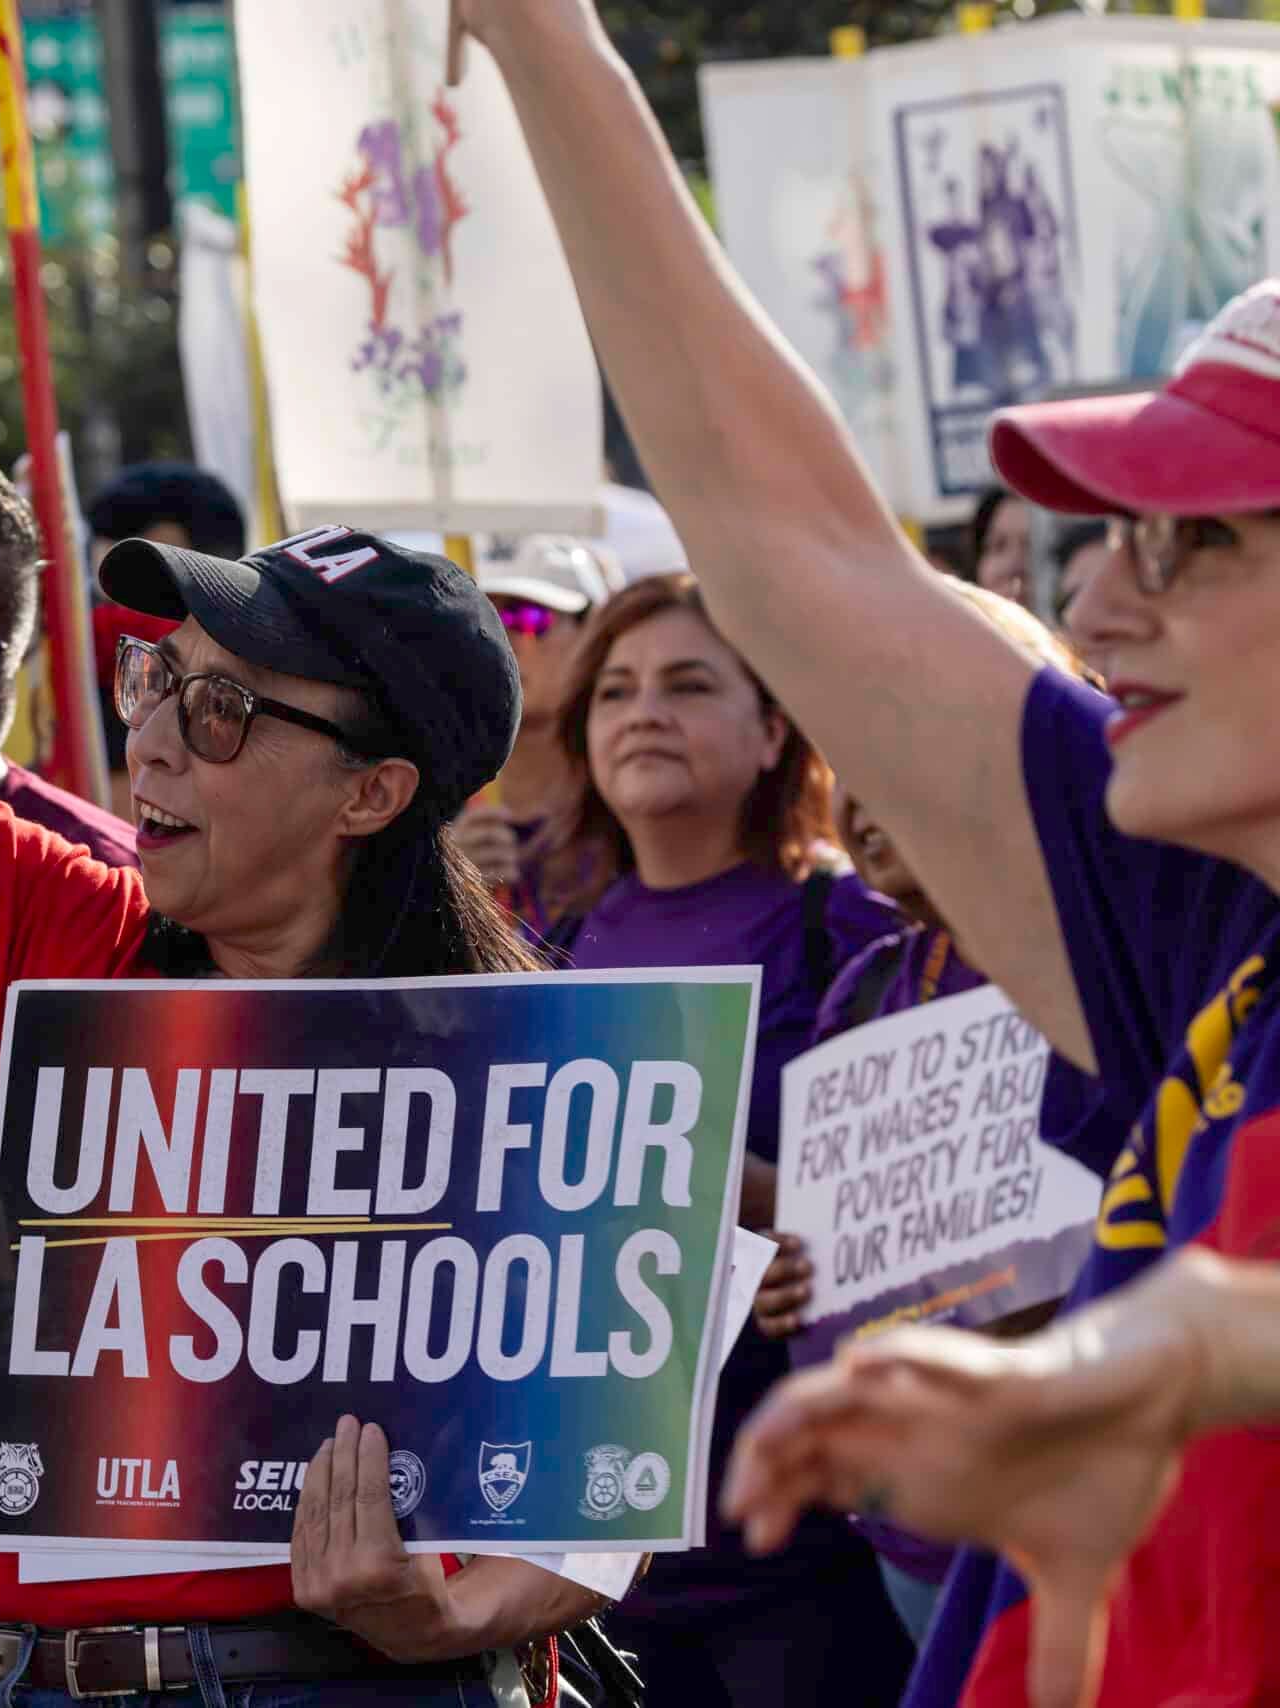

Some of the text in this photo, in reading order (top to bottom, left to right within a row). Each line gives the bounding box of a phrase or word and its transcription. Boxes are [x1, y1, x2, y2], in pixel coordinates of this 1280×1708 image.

[805, 1050, 898, 1127] READY
[907, 1032, 946, 1090] TO
[25, 1058, 703, 1215] UNITED FOR
[796, 1125, 851, 1187] FOR
[859, 1080, 963, 1161] WAGES
[833, 1116, 1037, 1231] POVERTY FOR
[834, 1224, 889, 1286] OUR
[8, 1236, 149, 1378] LA
[168, 1229, 681, 1384] SCHOOLS
[97, 1457, 180, 1499] UTLA
[233, 1494, 293, 1511] LOCAL
